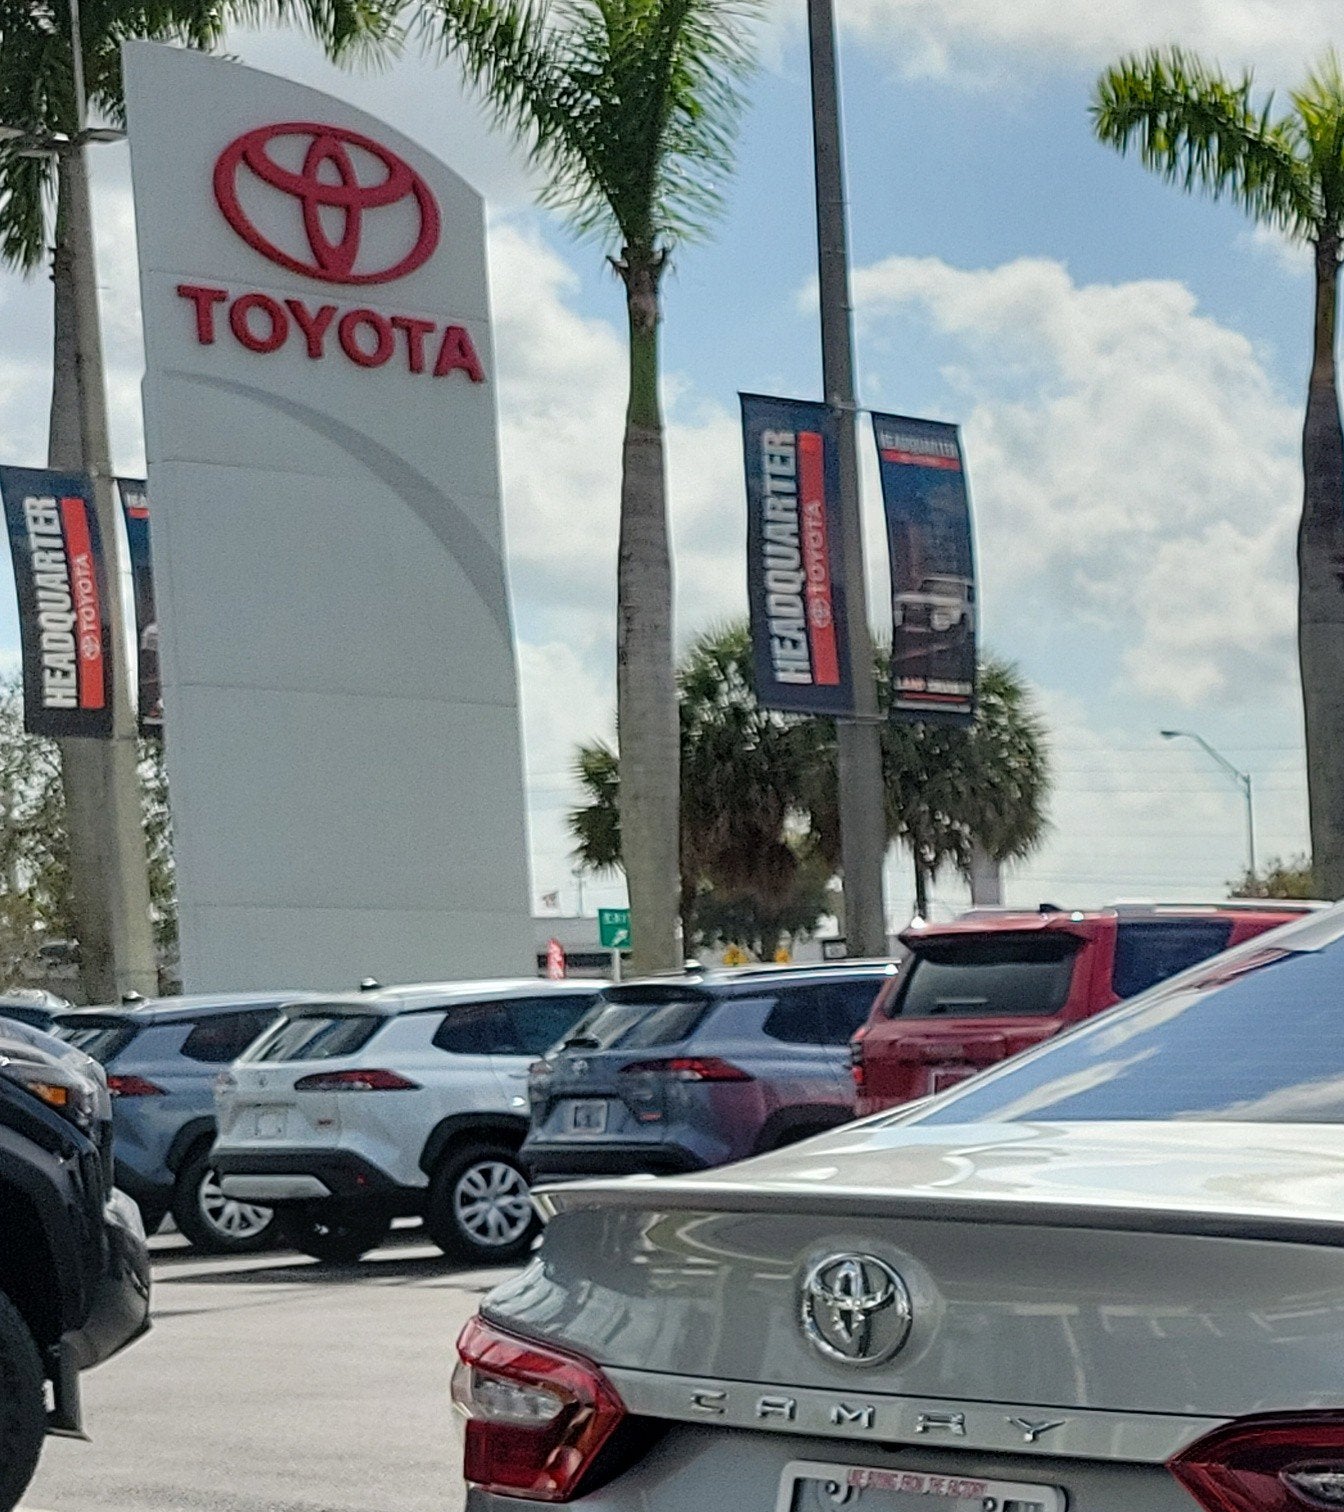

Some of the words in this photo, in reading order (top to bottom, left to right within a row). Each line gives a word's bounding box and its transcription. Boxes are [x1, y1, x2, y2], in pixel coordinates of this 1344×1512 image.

[176, 283, 485, 384] TOYOTA
[72, 553, 97, 632] TOYOTA
[761, 429, 813, 685] HEADQUARTER
[803, 500, 830, 595] TOYOTA
[24, 496, 78, 709] HEADQUARTER
[690, 1389, 1070, 1443] CAMRY
